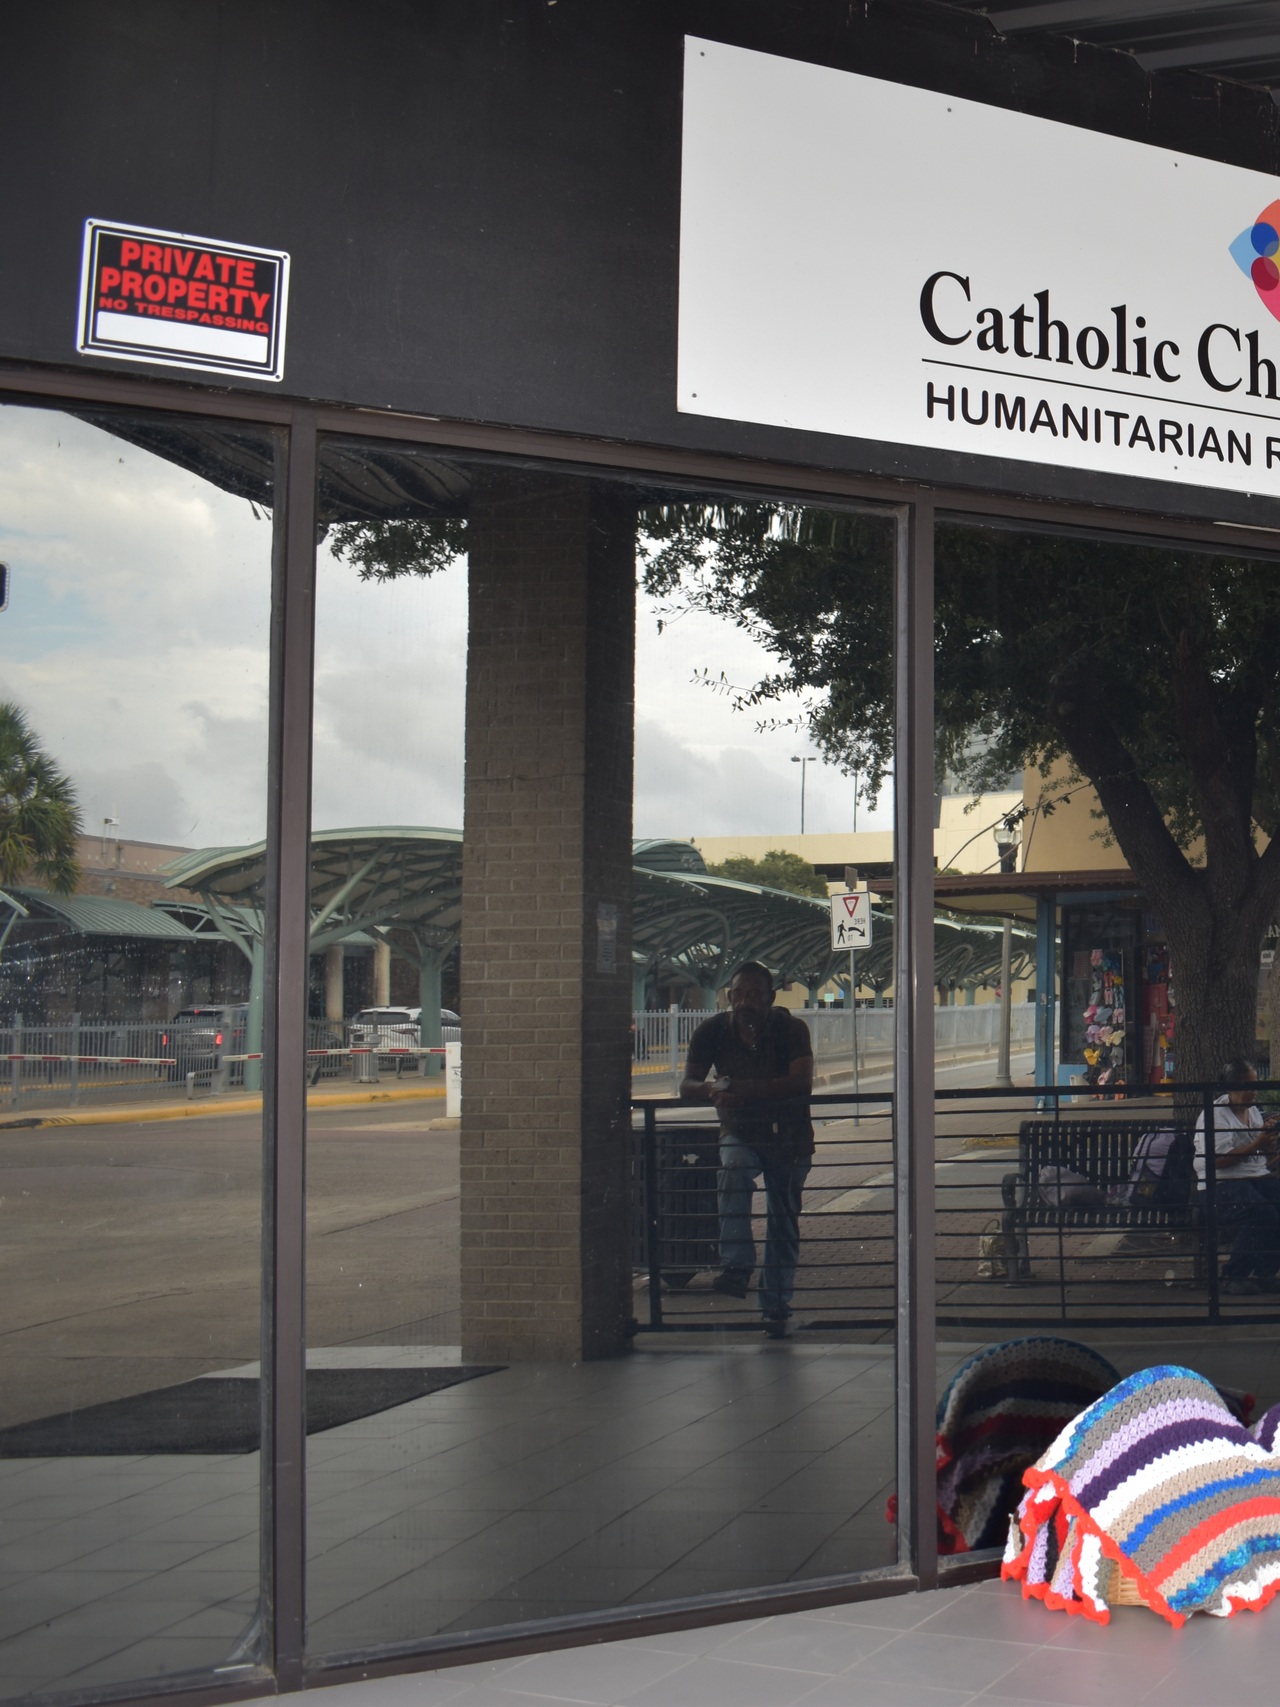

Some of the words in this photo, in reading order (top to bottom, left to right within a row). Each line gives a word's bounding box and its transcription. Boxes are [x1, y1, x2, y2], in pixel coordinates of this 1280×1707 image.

[120, 240, 256, 288] PRIVATE
[99, 297, 128, 311] NO
[135, 302, 270, 333] TRESPASSING
[100, 266, 271, 319] PROPERTY
[919, 270, 1182, 383] Catholic
[926, 381, 1252, 466] HUMANITARIAN
